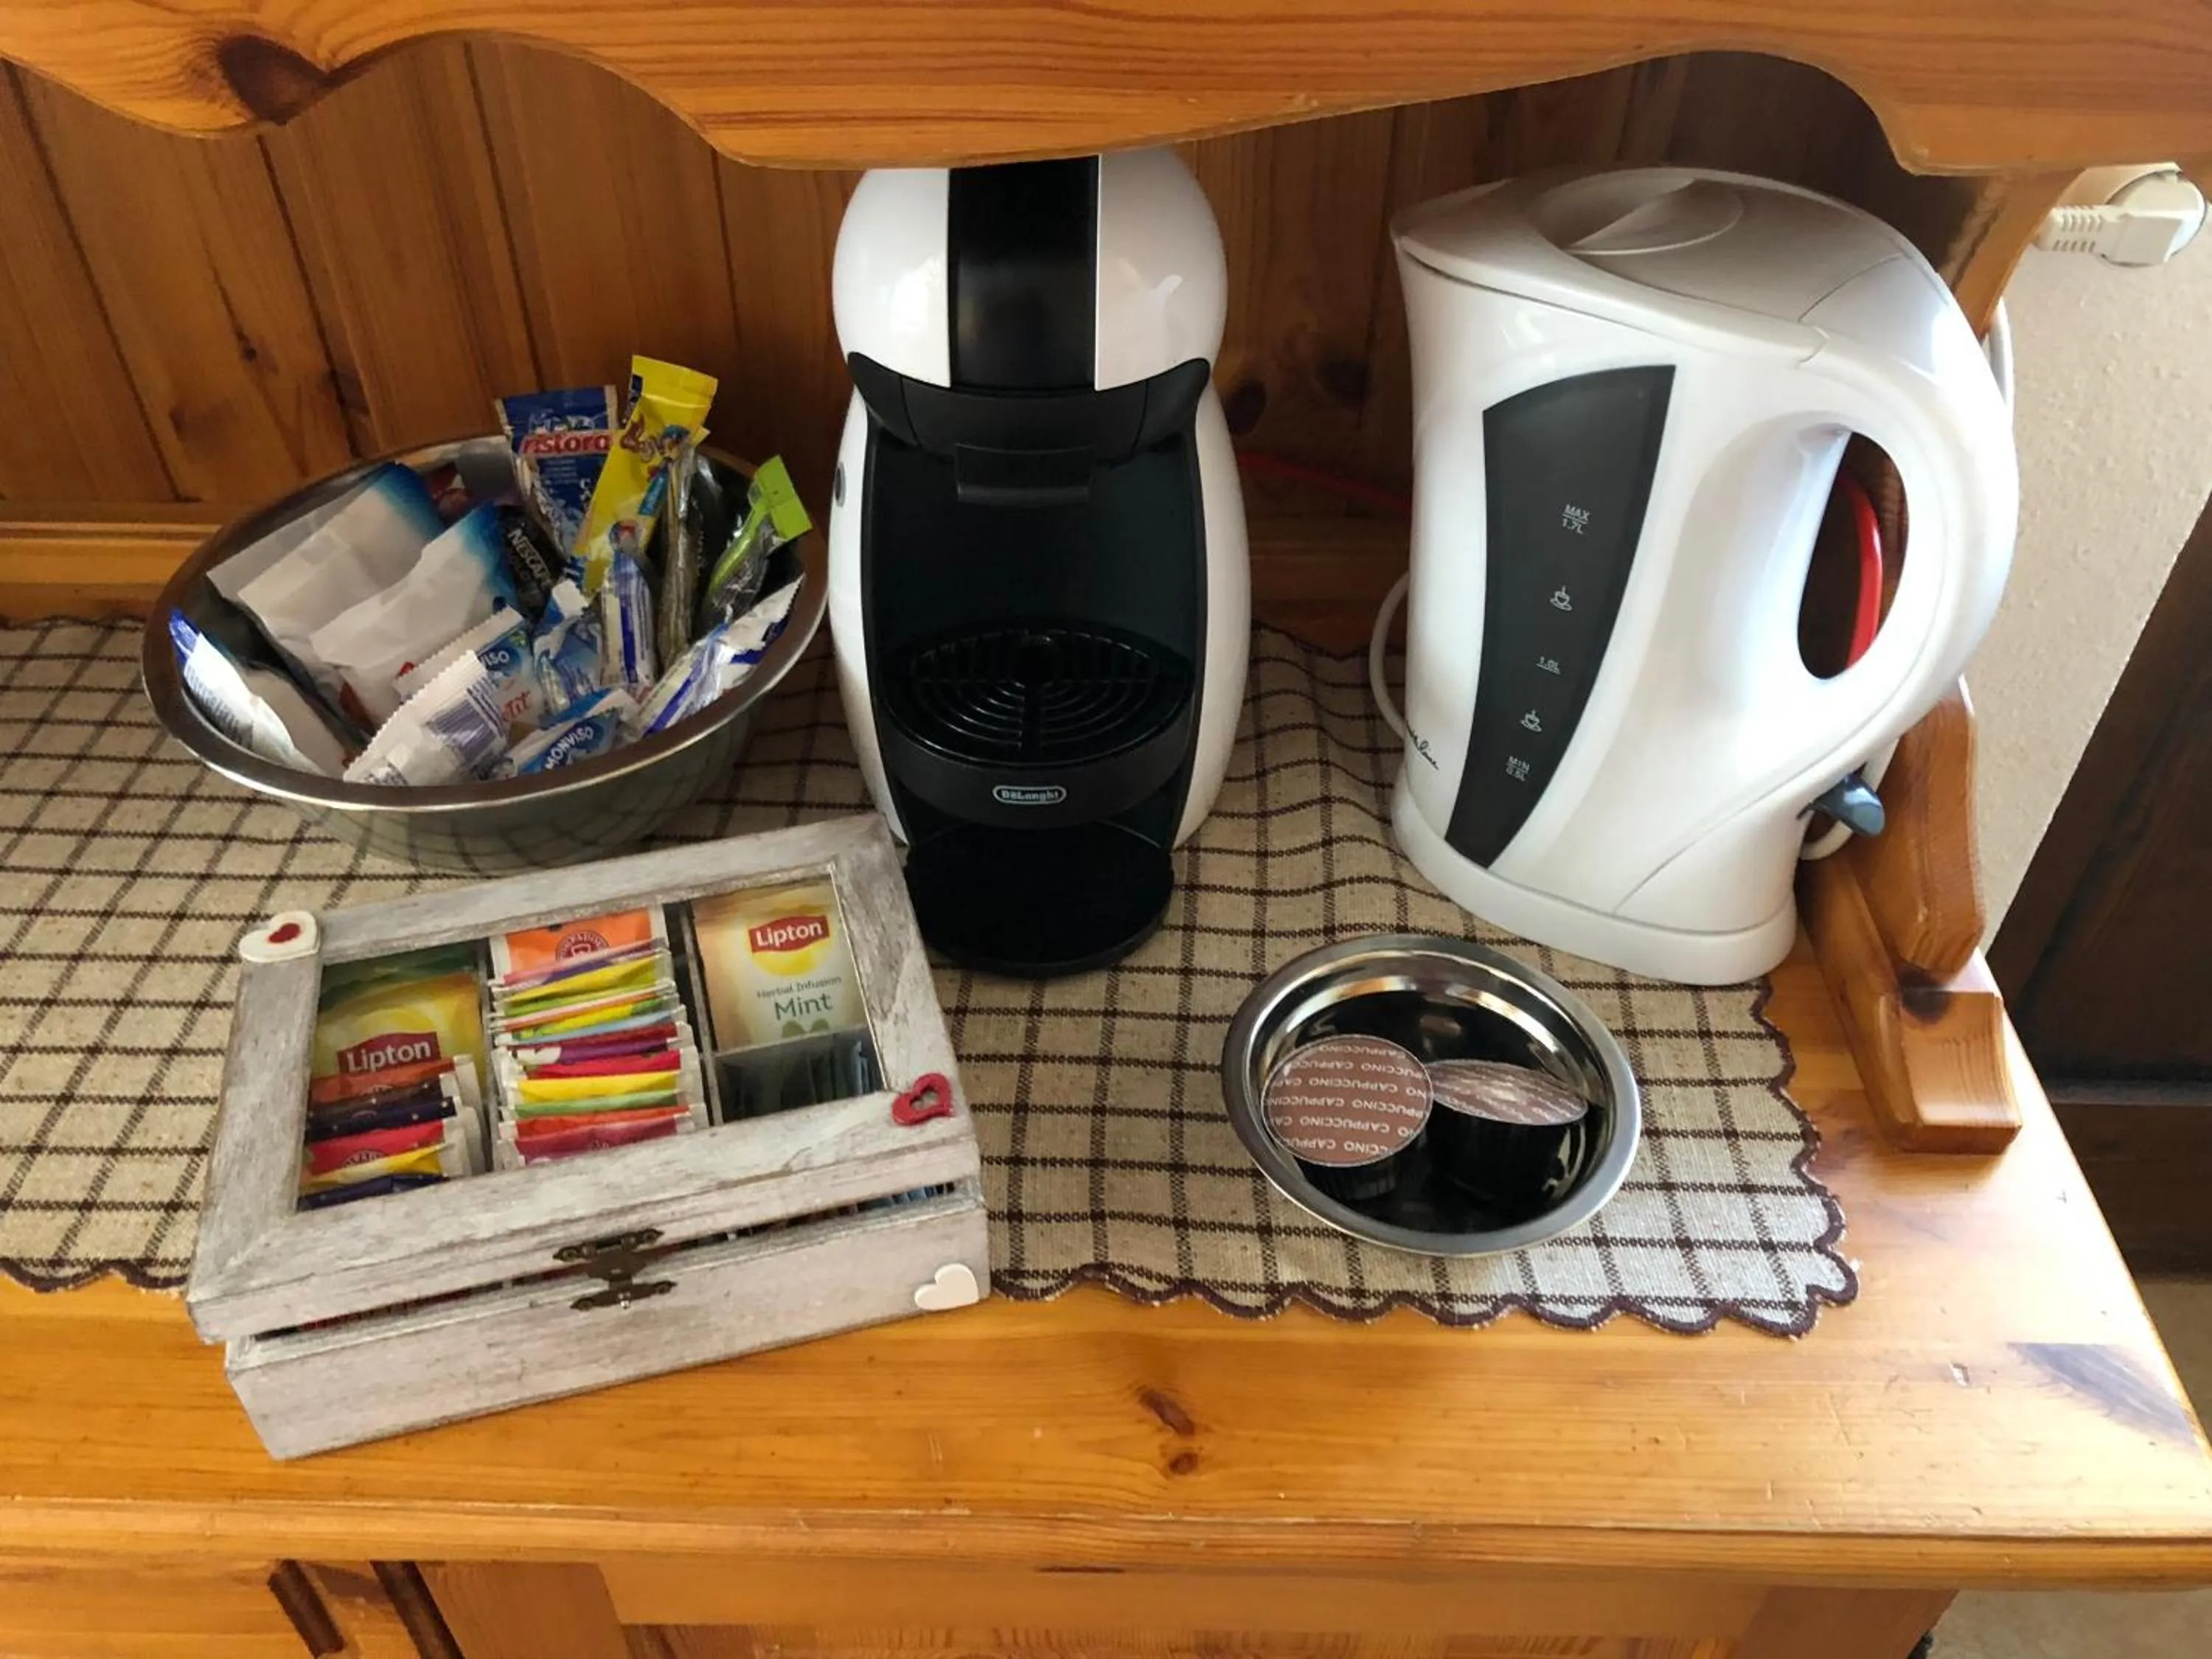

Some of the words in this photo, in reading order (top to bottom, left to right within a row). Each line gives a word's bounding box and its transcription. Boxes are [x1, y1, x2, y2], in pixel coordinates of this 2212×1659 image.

[1564, 504, 1590, 521] MAX
[754, 920, 824, 948] Lipton
[796, 975, 842, 992] Infusion
[774, 992, 834, 1020] Mint
[347, 1040, 431, 1072] Lipton
[1309, 1077, 1398, 1093] CAPPUCCINO
[1299, 1116, 1390, 1132] CAPPUCCINO
